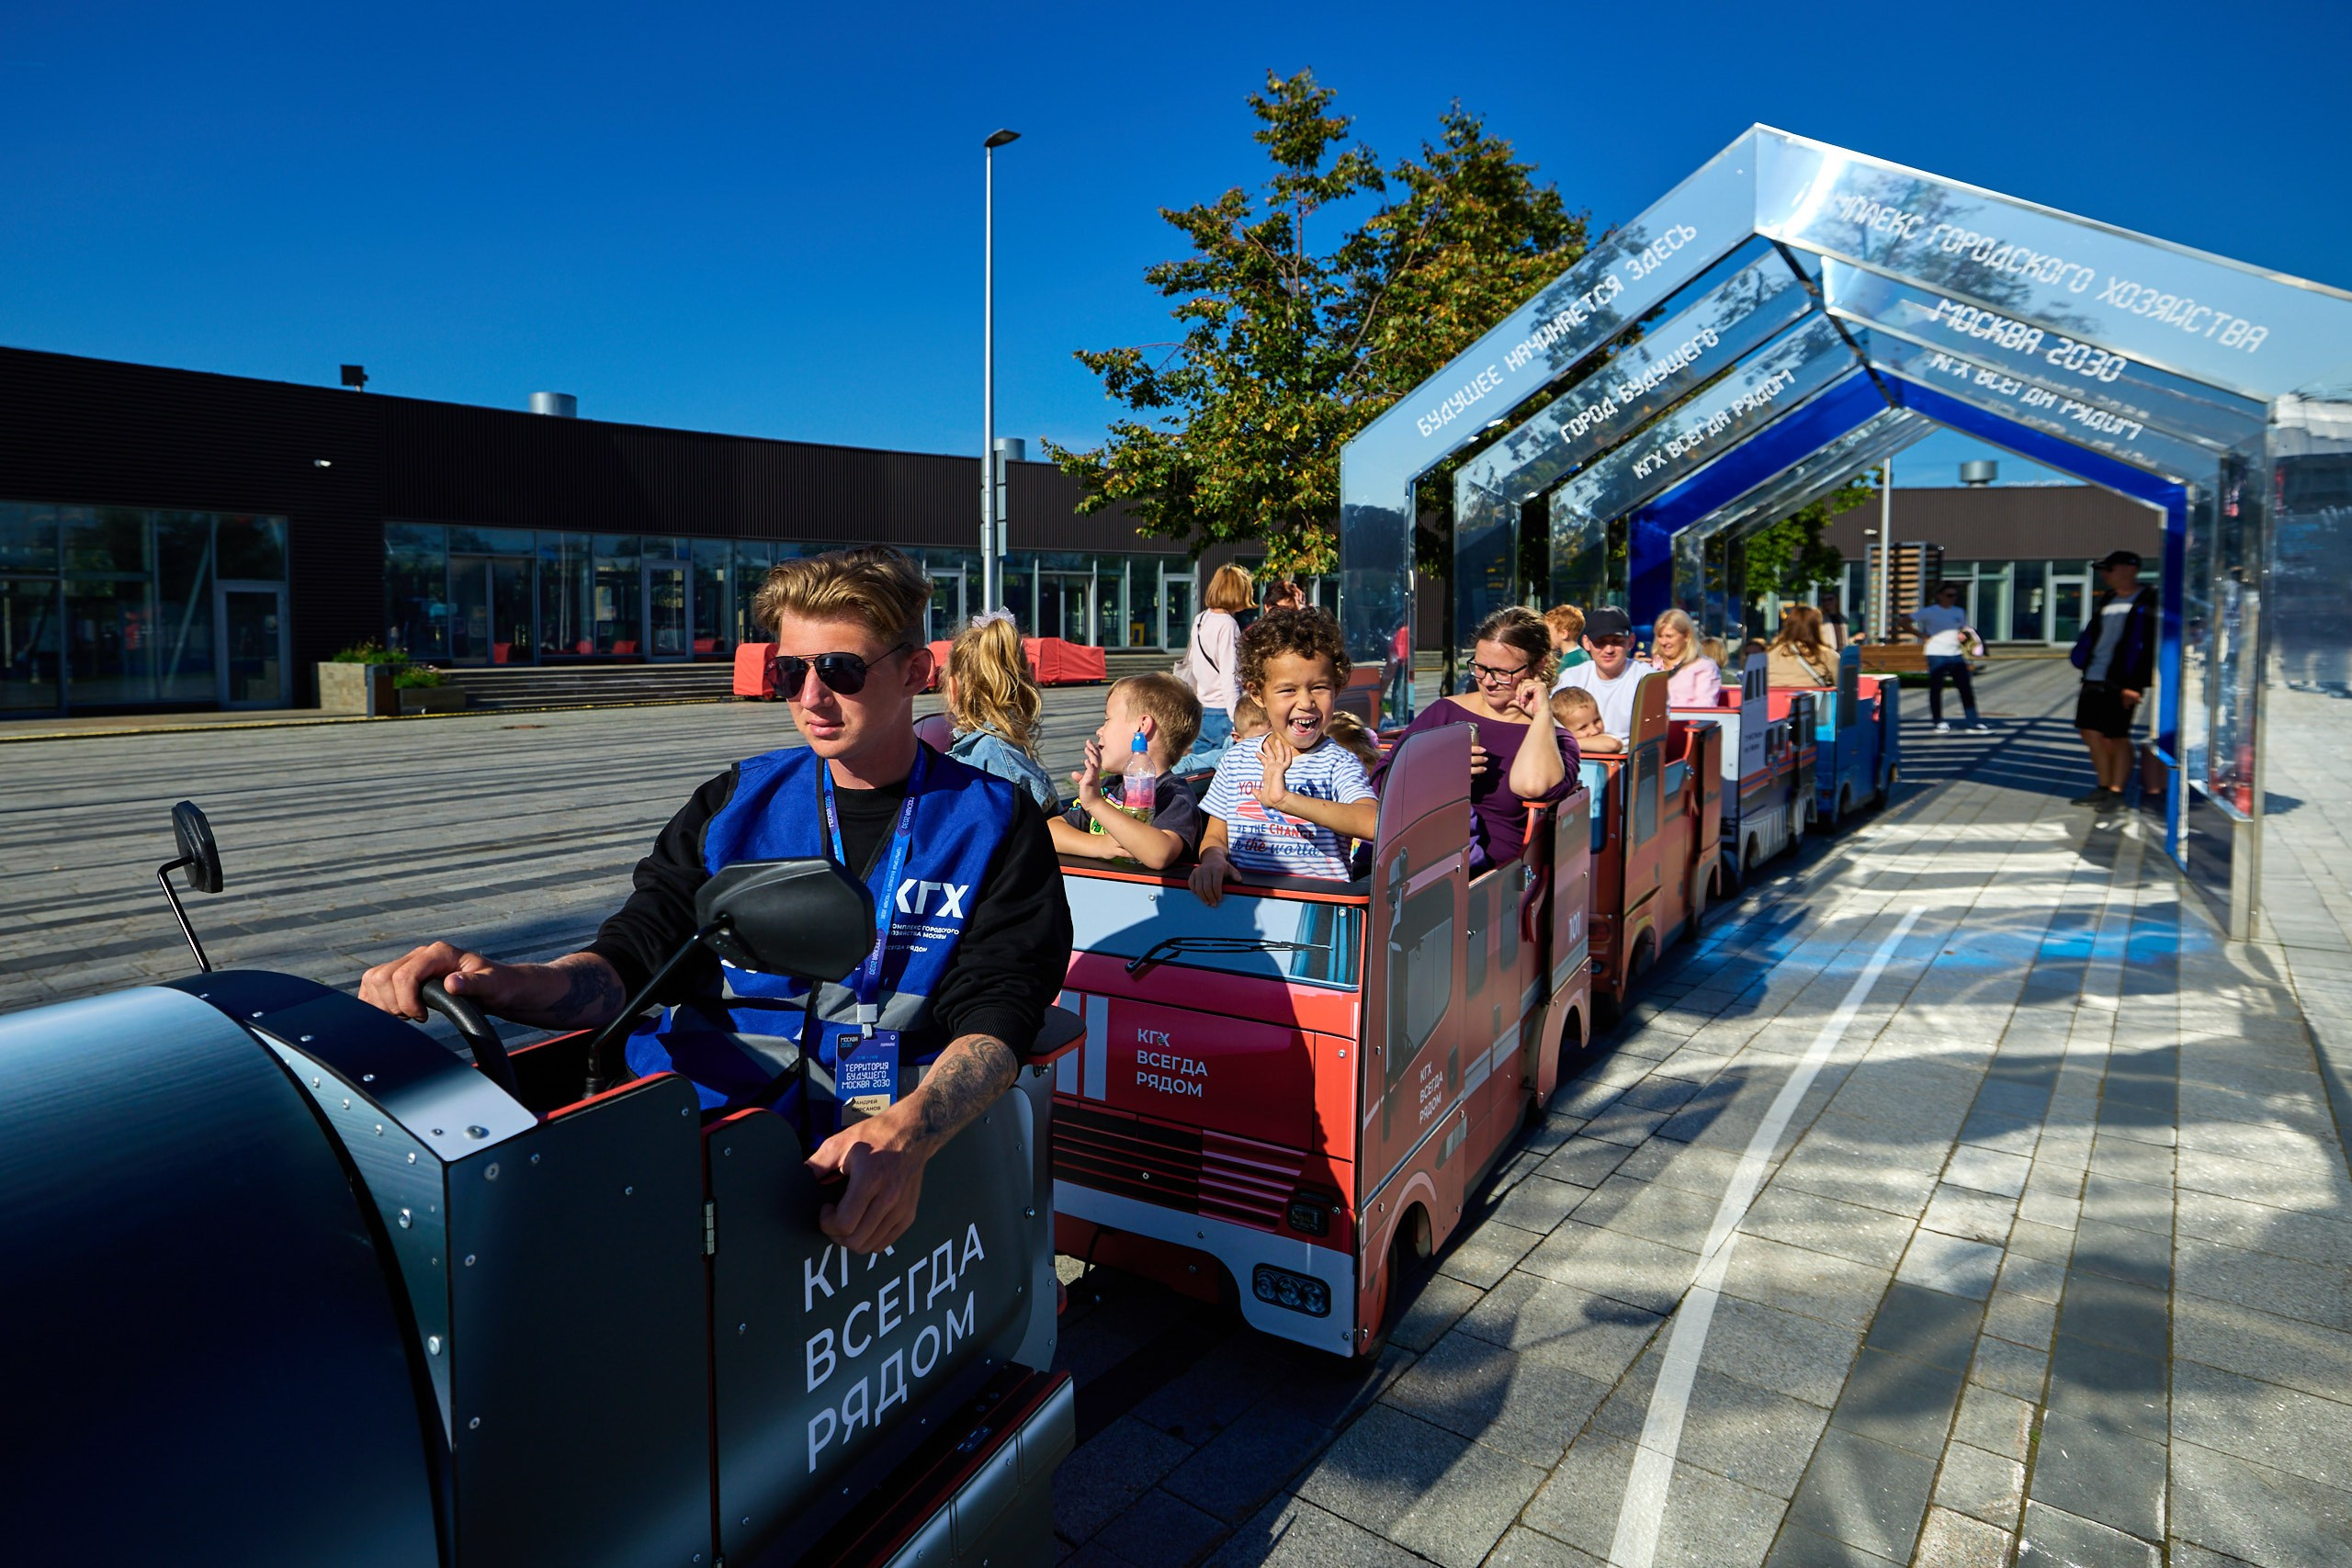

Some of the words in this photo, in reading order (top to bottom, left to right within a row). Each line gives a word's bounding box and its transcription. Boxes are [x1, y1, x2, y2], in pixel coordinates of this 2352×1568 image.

[1927, 223, 2095, 293] ГОРОДСКОГО
[2096, 276, 2268, 353] ХОЗЯЙСТВА
[1417, 365, 1503, 437] БУДУЩЕЕ
[1504, 275, 1624, 372] НАЧИНАЕТСЯ
[1624, 224, 1697, 280] ЗДЕСЬ
[1929, 298, 2044, 355] МОСКВА
[2045, 337, 2128, 383] 2030
[1560, 395, 1619, 443] ГОРОД
[1618, 329, 1719, 404] БУДУЩЕГО
[1632, 449, 1668, 479] КГХ
[1665, 411, 1732, 459] ВСЕГДА
[1731, 368, 1795, 417] РЯДОМ
[1237, 824, 1247, 833] BE
[1250, 824, 1266, 833] THE
[1269, 823, 1315, 840] CHANGE
[1245, 838, 1267, 852] the
[1271, 842, 1320, 856] world
[896, 877, 969, 919] КГХ
[922, 925, 959, 935] ГОРОДСКОГО
[1569, 911, 1581, 942] 101
[1137, 1028, 1170, 1047] КГХ
[845, 1062, 889, 1072] ТЕРРИТОРИЯ
[846, 1070, 887, 1081] БУДУЩЕГО
[1136, 1049, 1208, 1077] ВСЕГДА
[1420, 1061, 1431, 1083] КГХ
[842, 1080, 870, 1089] МОСКВА
[873, 1079, 890, 1088] 2030
[1136, 1071, 1202, 1098] РЯДОМ
[1420, 1071, 1443, 1104] ВСЕГДА
[1419, 1090, 1442, 1124] РЯДОМ
[804, 1222, 985, 1394] ВСЕГДА
[807, 1291, 975, 1473] РЯДОМ
